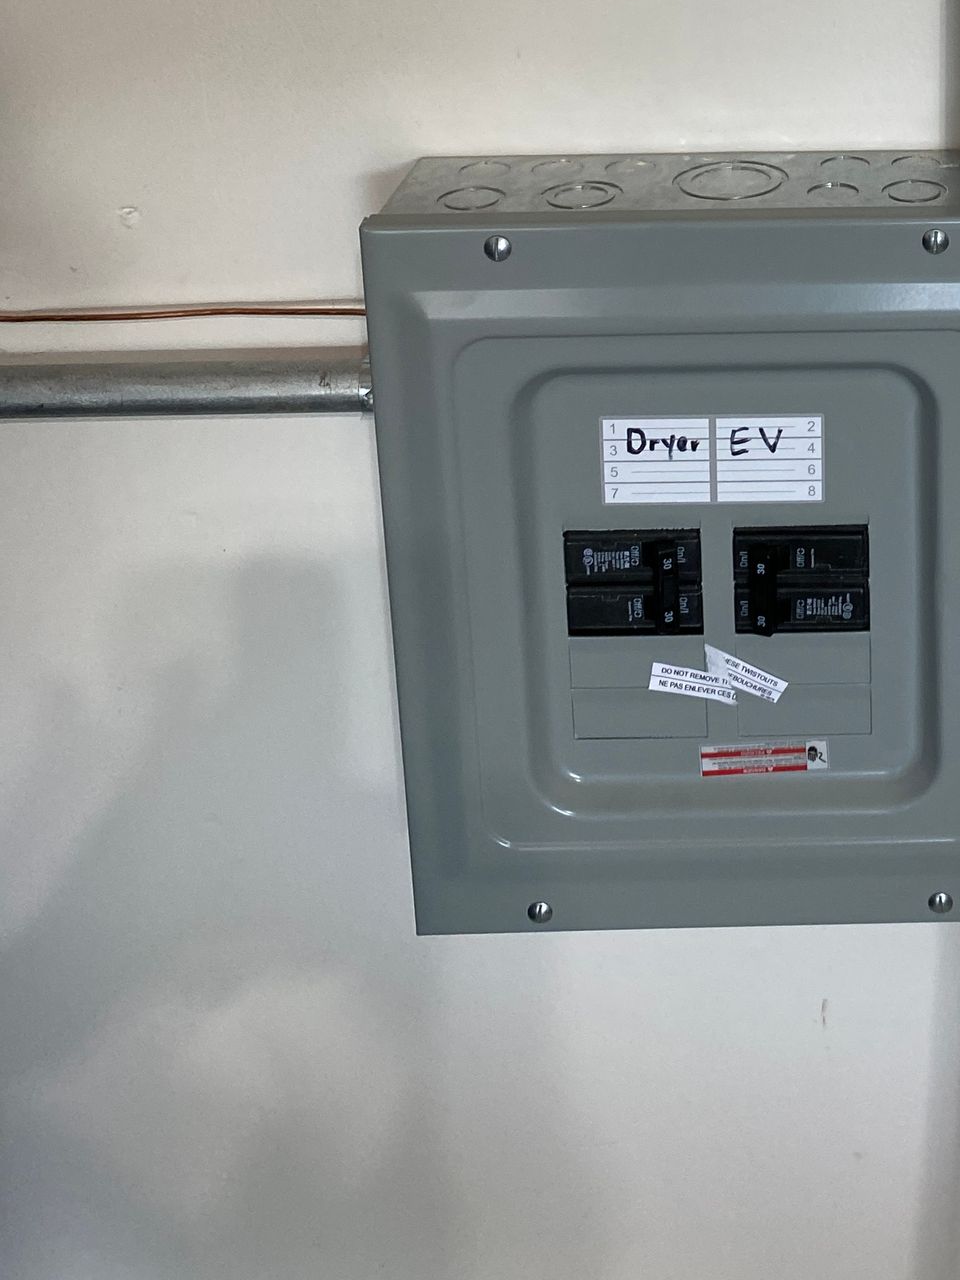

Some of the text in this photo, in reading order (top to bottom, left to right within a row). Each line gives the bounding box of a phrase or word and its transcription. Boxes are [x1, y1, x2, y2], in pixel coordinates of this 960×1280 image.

[609, 423, 616, 435] 1
[807, 421, 816, 433] 2
[626, 427, 700, 460] Dryer
[807, 442, 817, 454] 4
[609, 445, 618, 456] 3
[610, 466, 619, 478] 5
[807, 464, 816, 475] 6
[611, 487, 620, 499] 7
[807, 485, 816, 497] 8
[663, 558, 672, 570] 30
[757, 563, 766, 575] 30
[664, 610, 674, 623] 30
[757, 616, 766, 627] 30
[661, 666, 673, 675] DO
[673, 669, 689, 679] NOT
[689, 672, 720, 684] REMOVE
[741, 665, 779, 687] TWISTOUTS
[658, 679, 669, 687] NE
[669, 681, 684, 690] PAS
[684, 684, 716, 695] ENLEVER
[717, 688, 732, 699] CES
